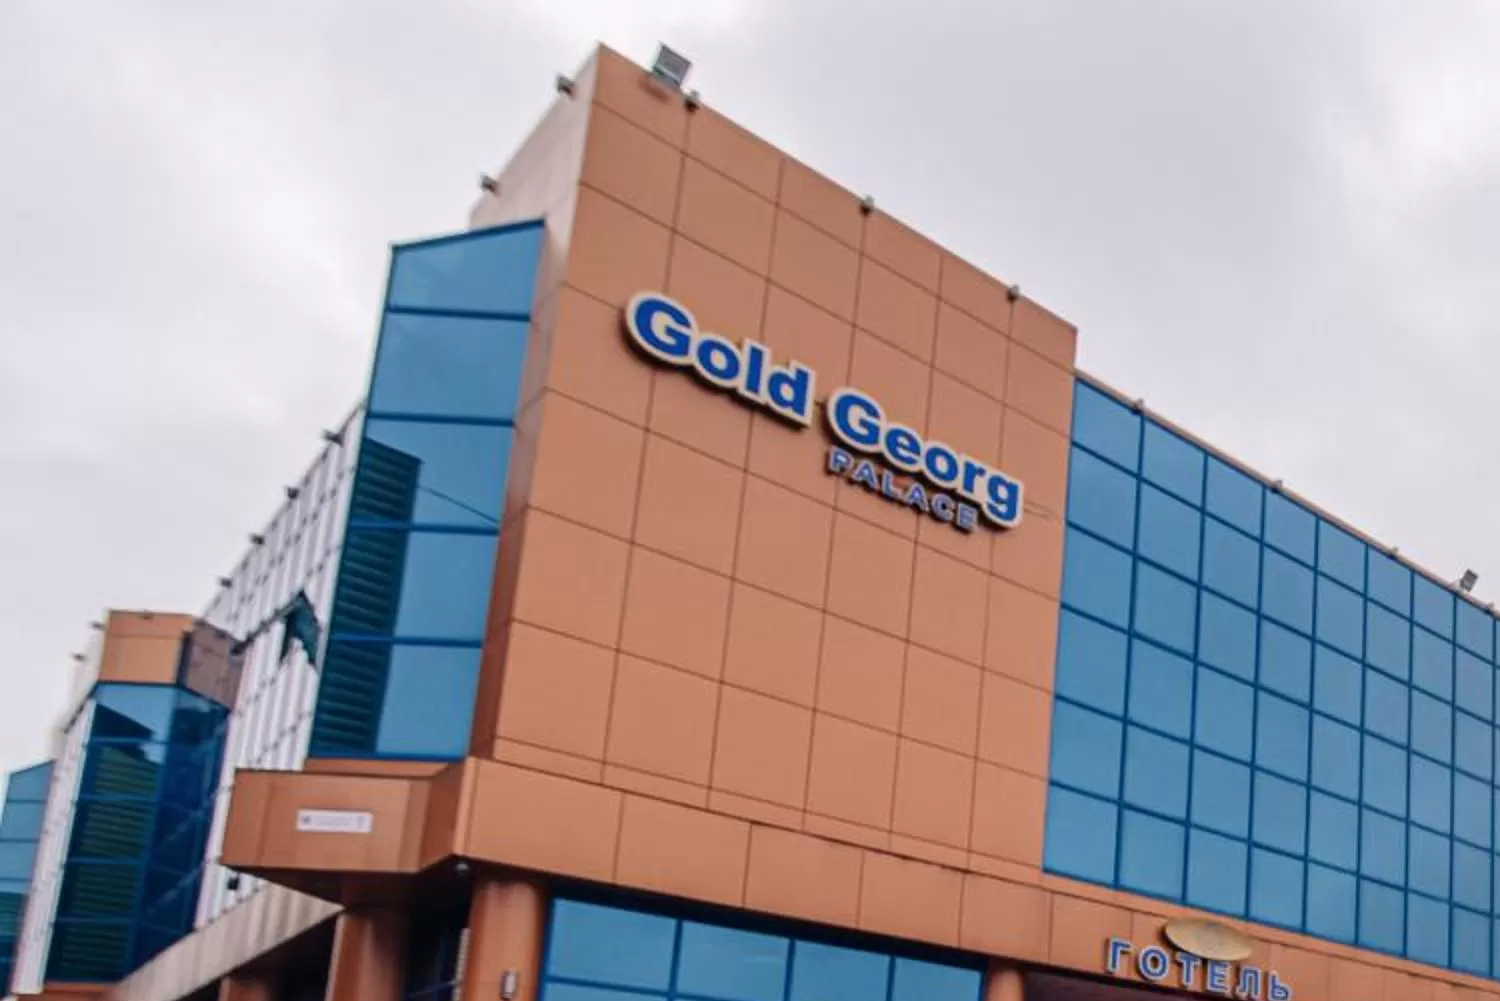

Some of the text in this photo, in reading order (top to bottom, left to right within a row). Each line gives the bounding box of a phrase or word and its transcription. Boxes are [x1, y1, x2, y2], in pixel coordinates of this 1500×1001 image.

[628, 291, 1023, 530] Gold Georg
[828, 446, 980, 530] PALACE
